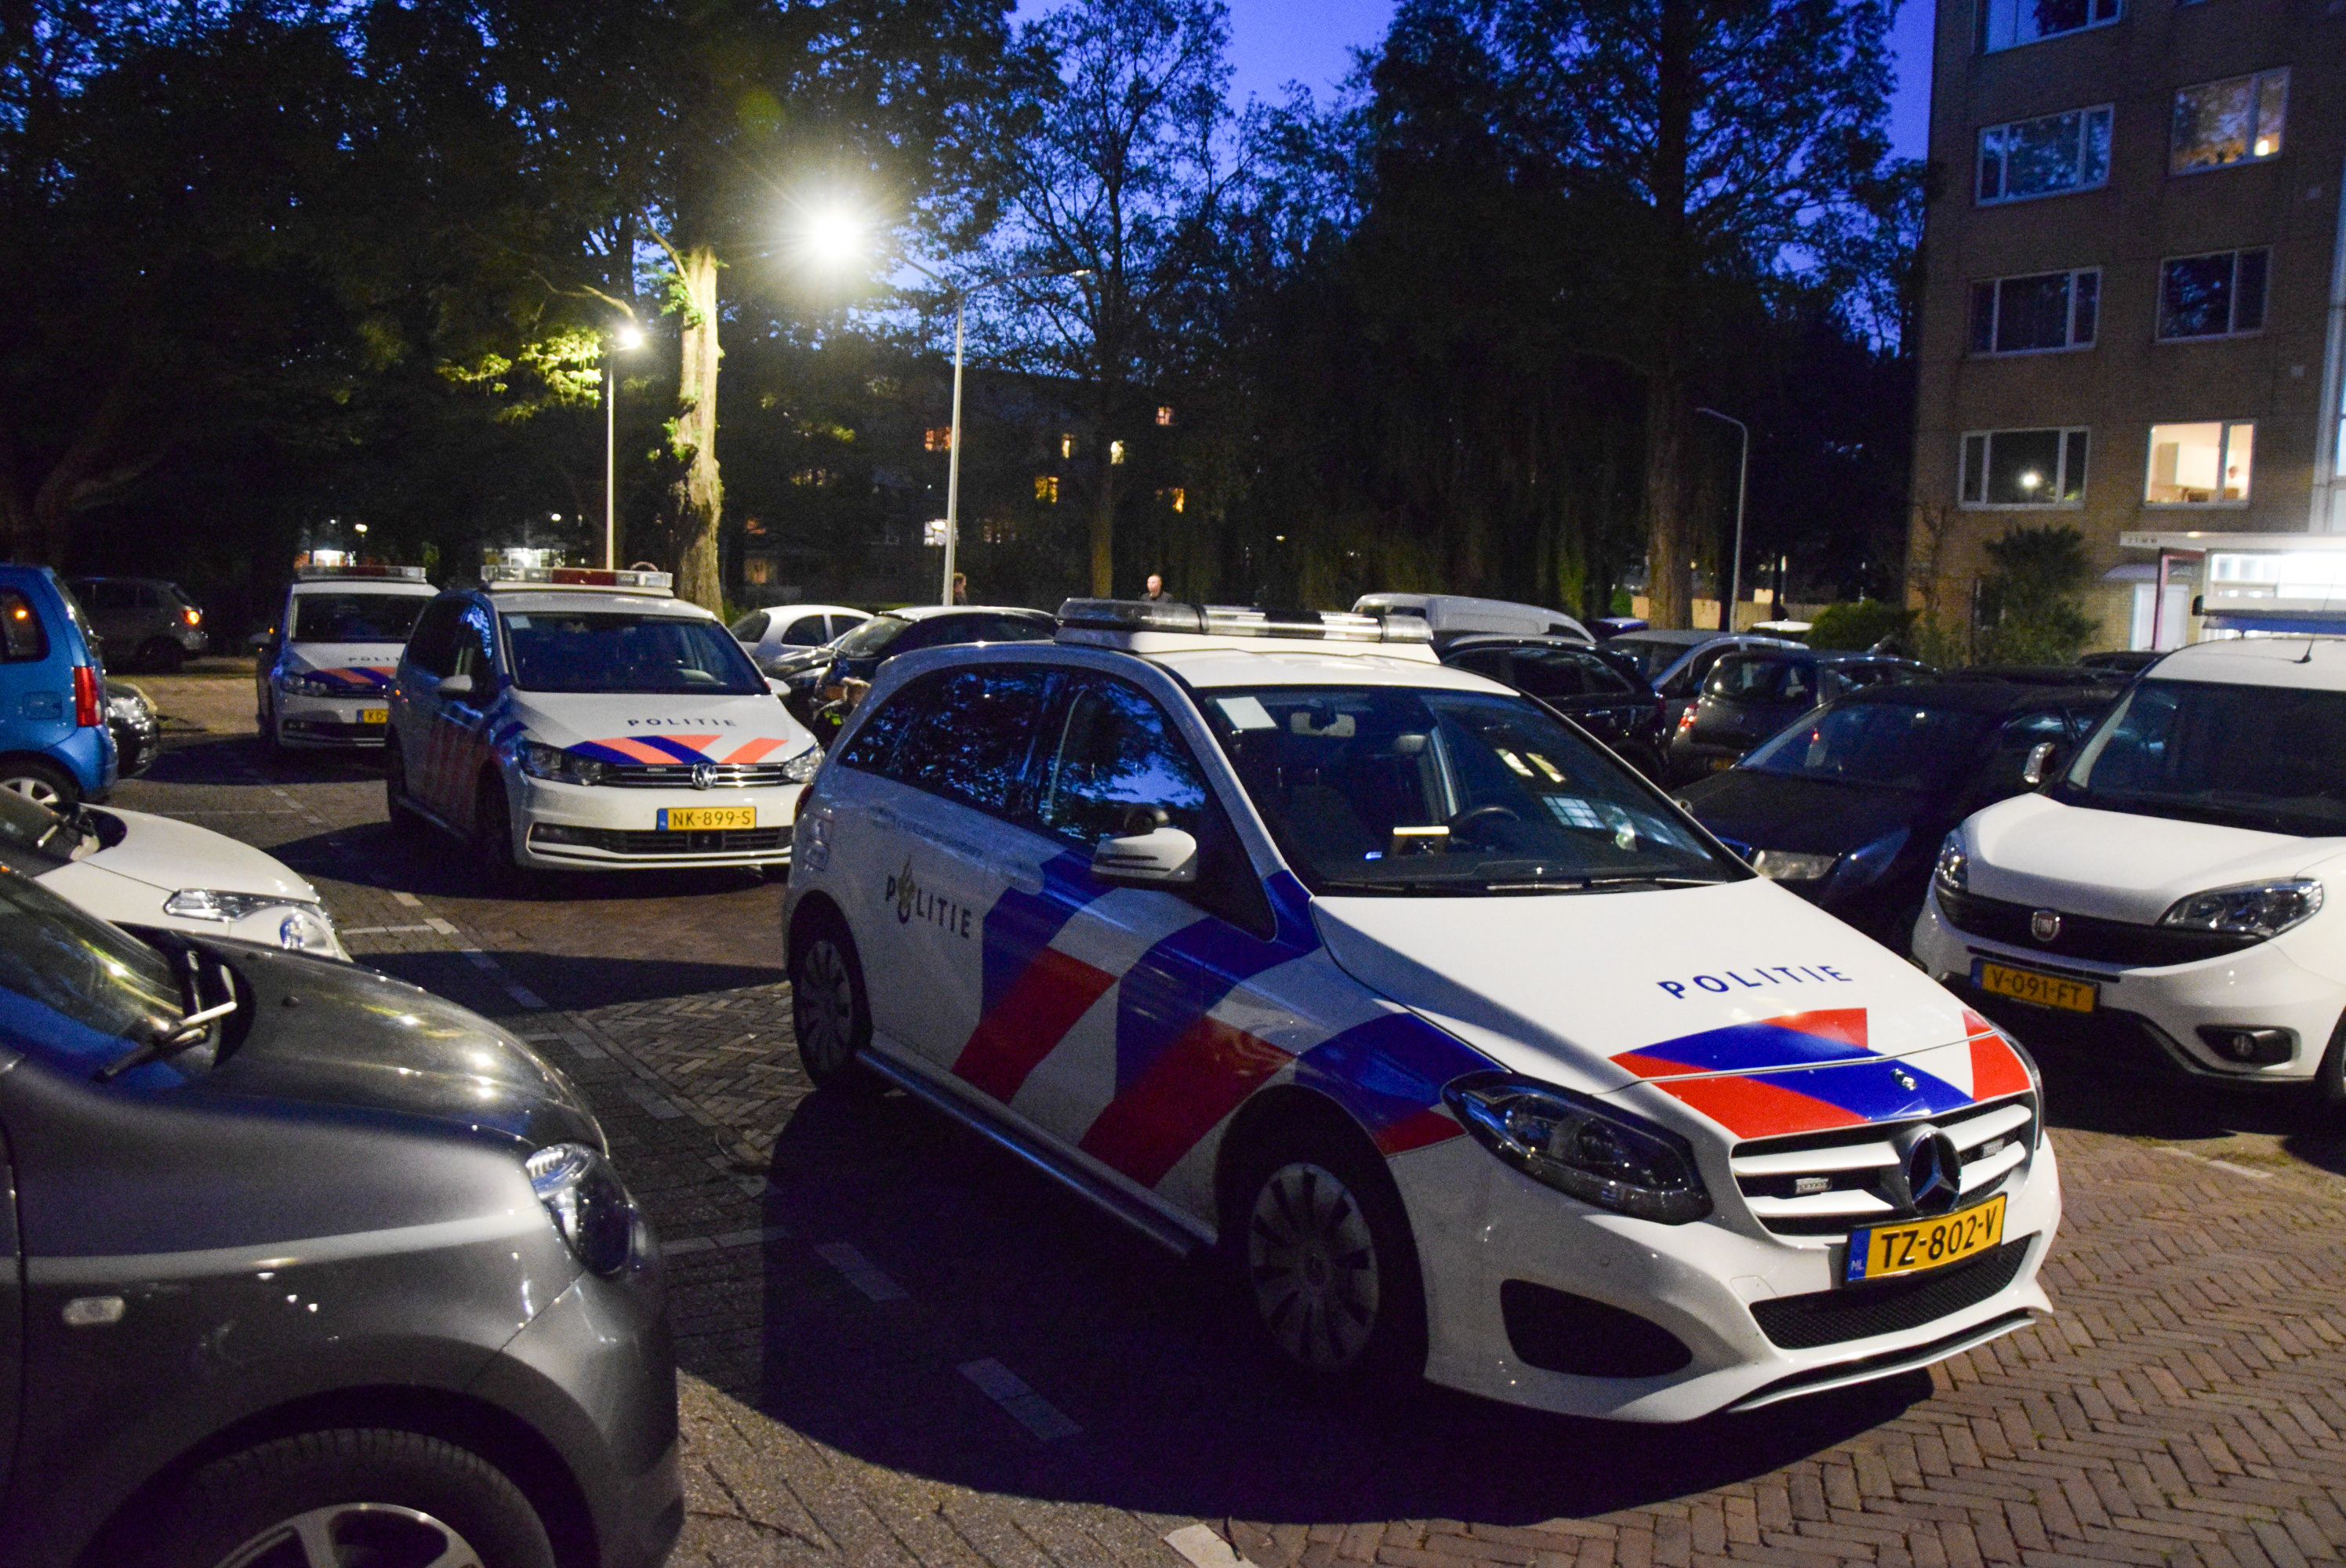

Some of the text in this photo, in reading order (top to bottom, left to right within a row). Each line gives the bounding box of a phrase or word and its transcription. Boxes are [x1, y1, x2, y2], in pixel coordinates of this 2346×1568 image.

[627, 718, 737, 727] POLITIE
[673, 810, 751, 826] NK-899-S
[885, 873, 972, 939] POLITIE
[1656, 965, 1854, 1000] POLITIE
[1992, 968, 2083, 1004] V-091-FT
[1881, 1205, 1998, 1269] TZ-802-V
